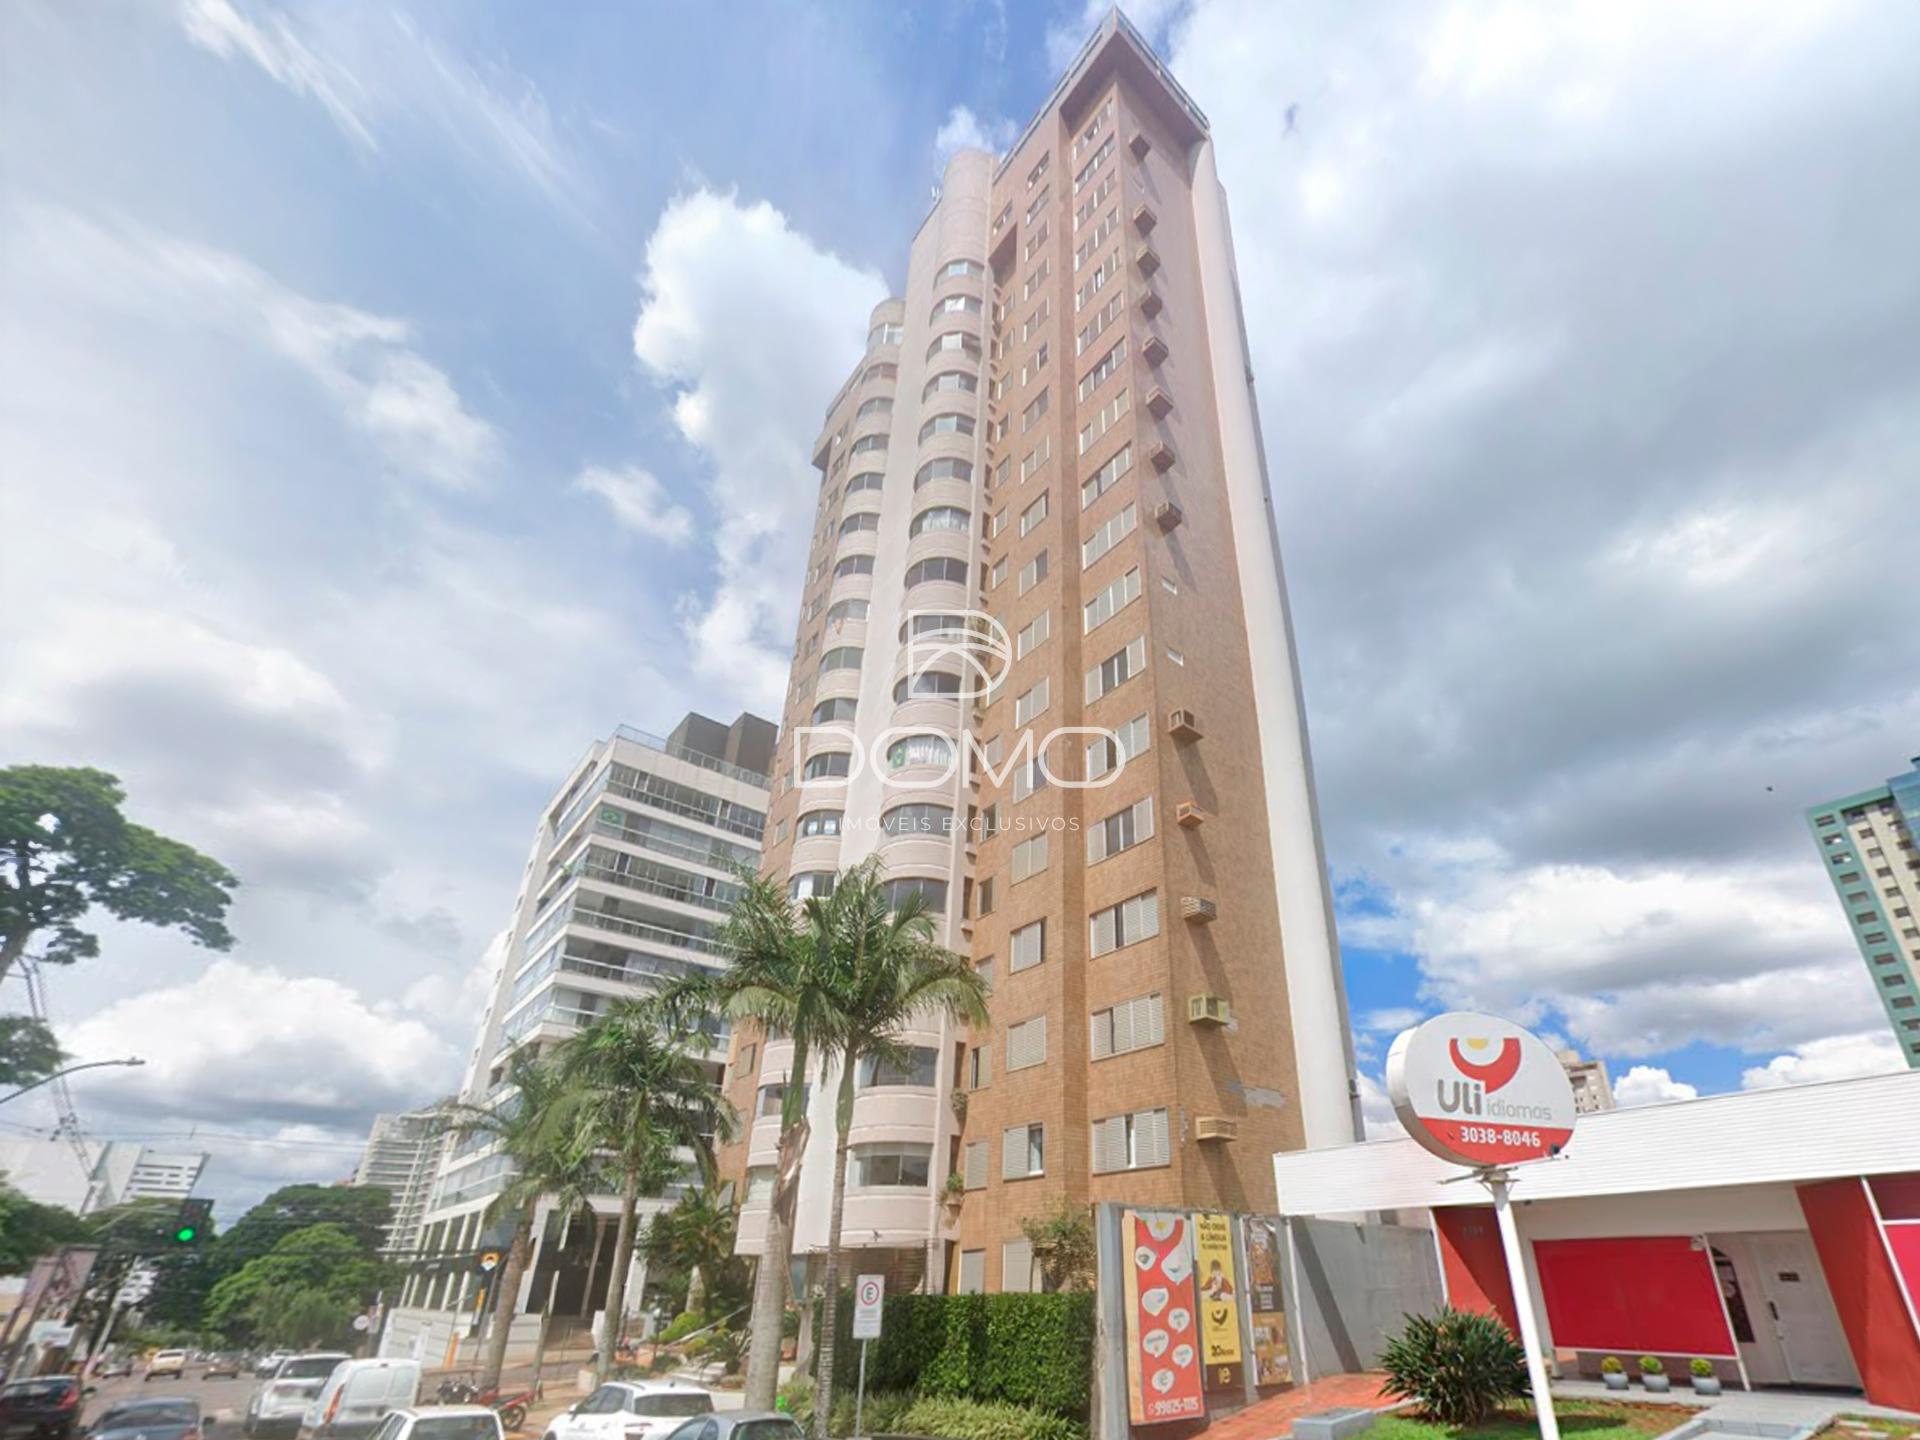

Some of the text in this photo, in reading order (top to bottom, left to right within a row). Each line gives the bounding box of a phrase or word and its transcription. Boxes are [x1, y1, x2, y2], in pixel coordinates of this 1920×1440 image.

[1486, 1099, 1552, 1121] idiomas
[1460, 1126, 1541, 1147] 3038-8046
[866, 1287, 874, 1300] E
